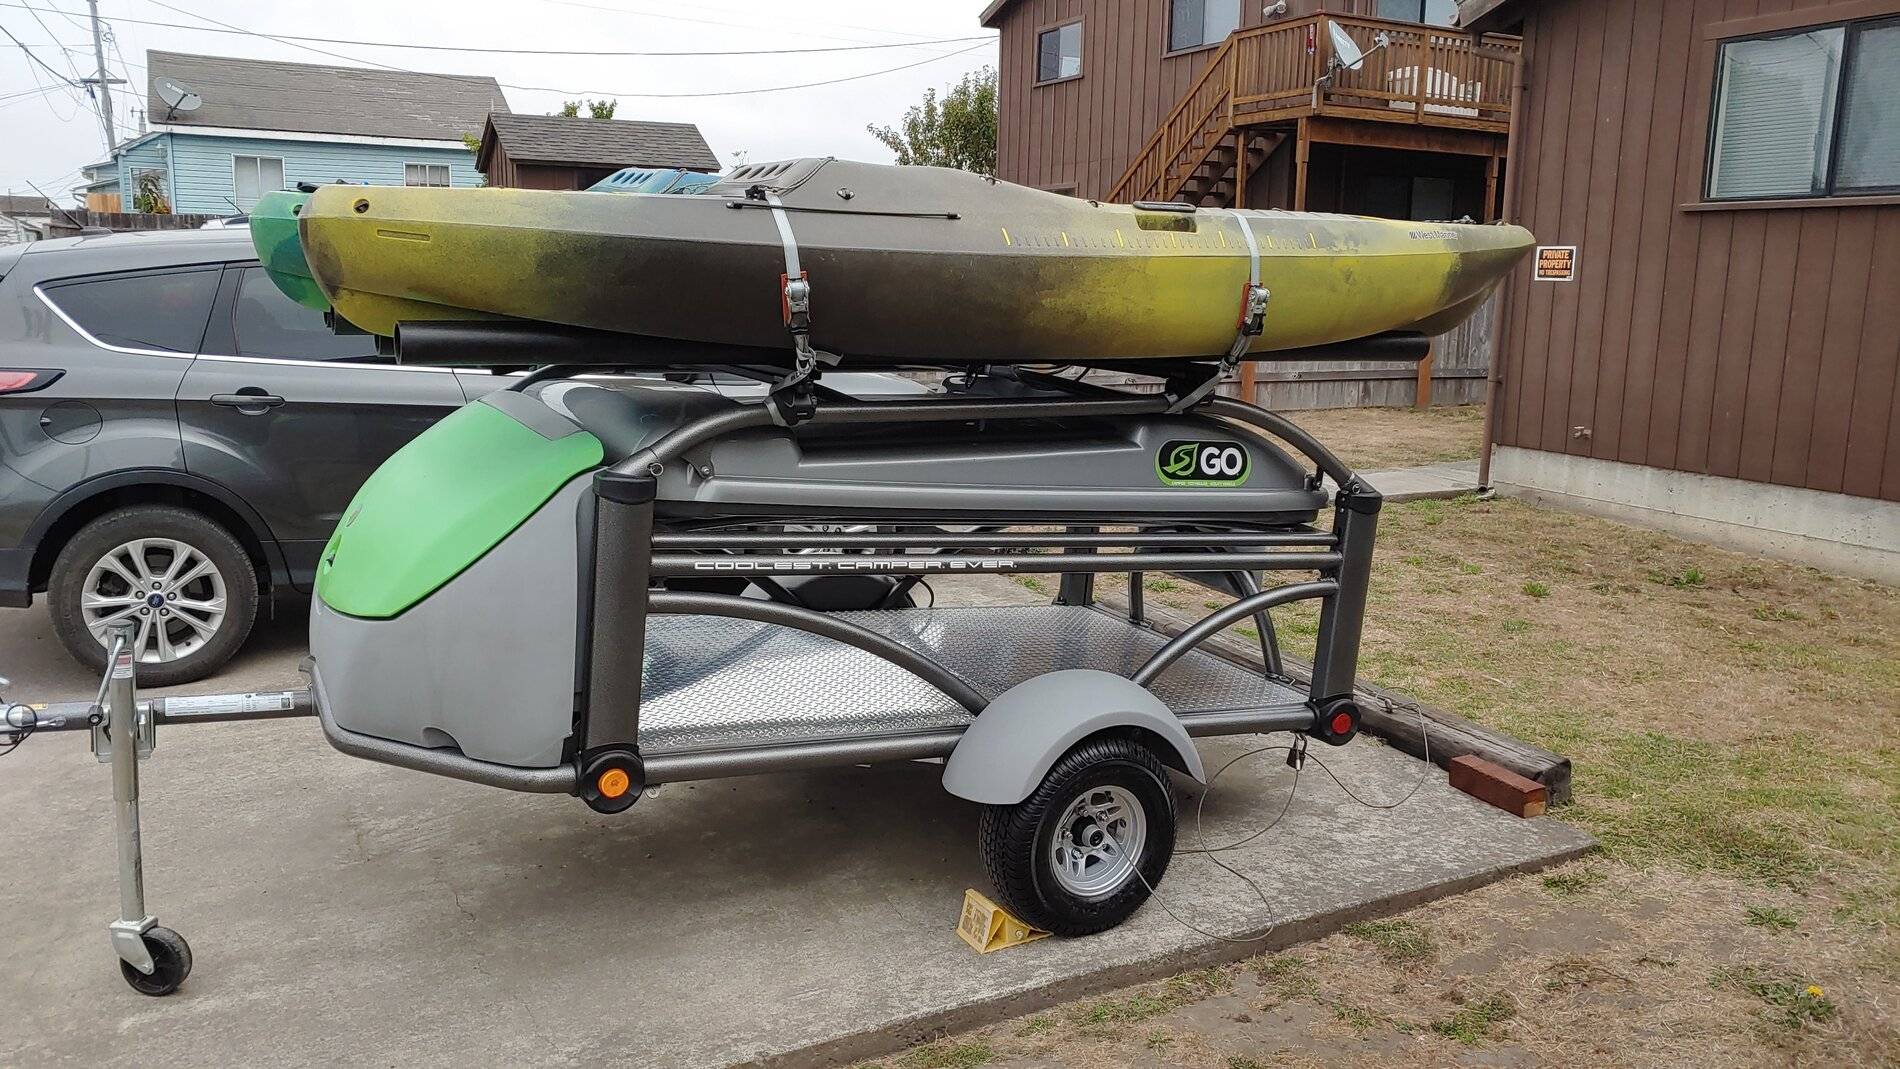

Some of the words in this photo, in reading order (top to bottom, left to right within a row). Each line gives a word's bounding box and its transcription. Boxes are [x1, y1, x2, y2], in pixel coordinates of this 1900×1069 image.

[1543, 250, 1570, 259] PRIVATE
[1539, 259, 1572, 269] PROPERTY
[1200, 446, 1243, 476] GO
[694, 561, 832, 570] COOLEST.
[837, 560, 946, 570] CAMPER.
[949, 559, 1018, 569] EVER.
